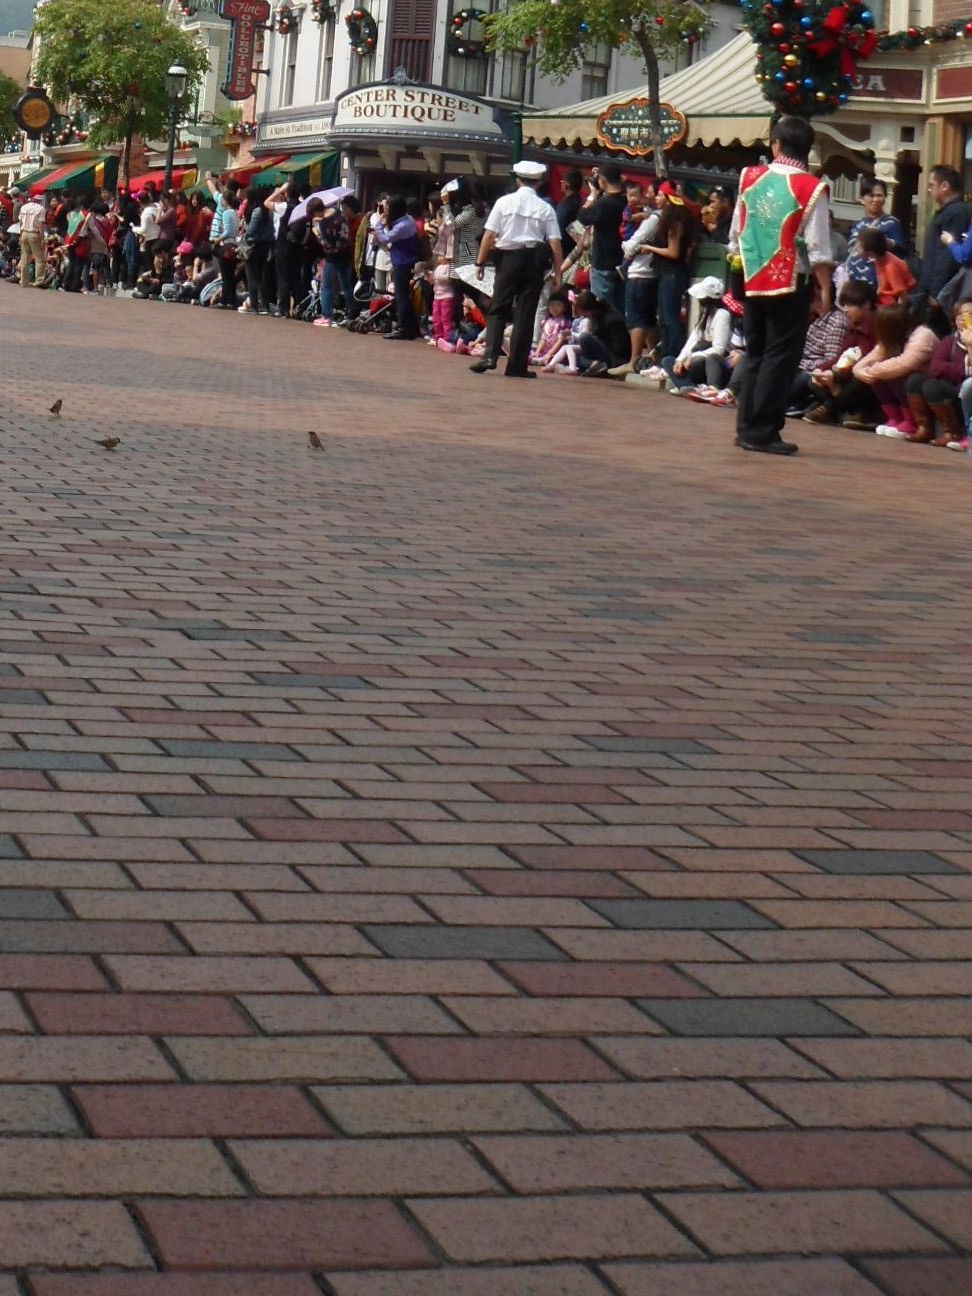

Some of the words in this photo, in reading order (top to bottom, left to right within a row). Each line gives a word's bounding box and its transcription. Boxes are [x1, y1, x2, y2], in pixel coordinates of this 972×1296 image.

[231, 2, 263, 16] Fine
[341, 89, 397, 110] CENTER
[404, 89, 485, 115] STREET
[353, 104, 456, 122] BOUTIQUE
